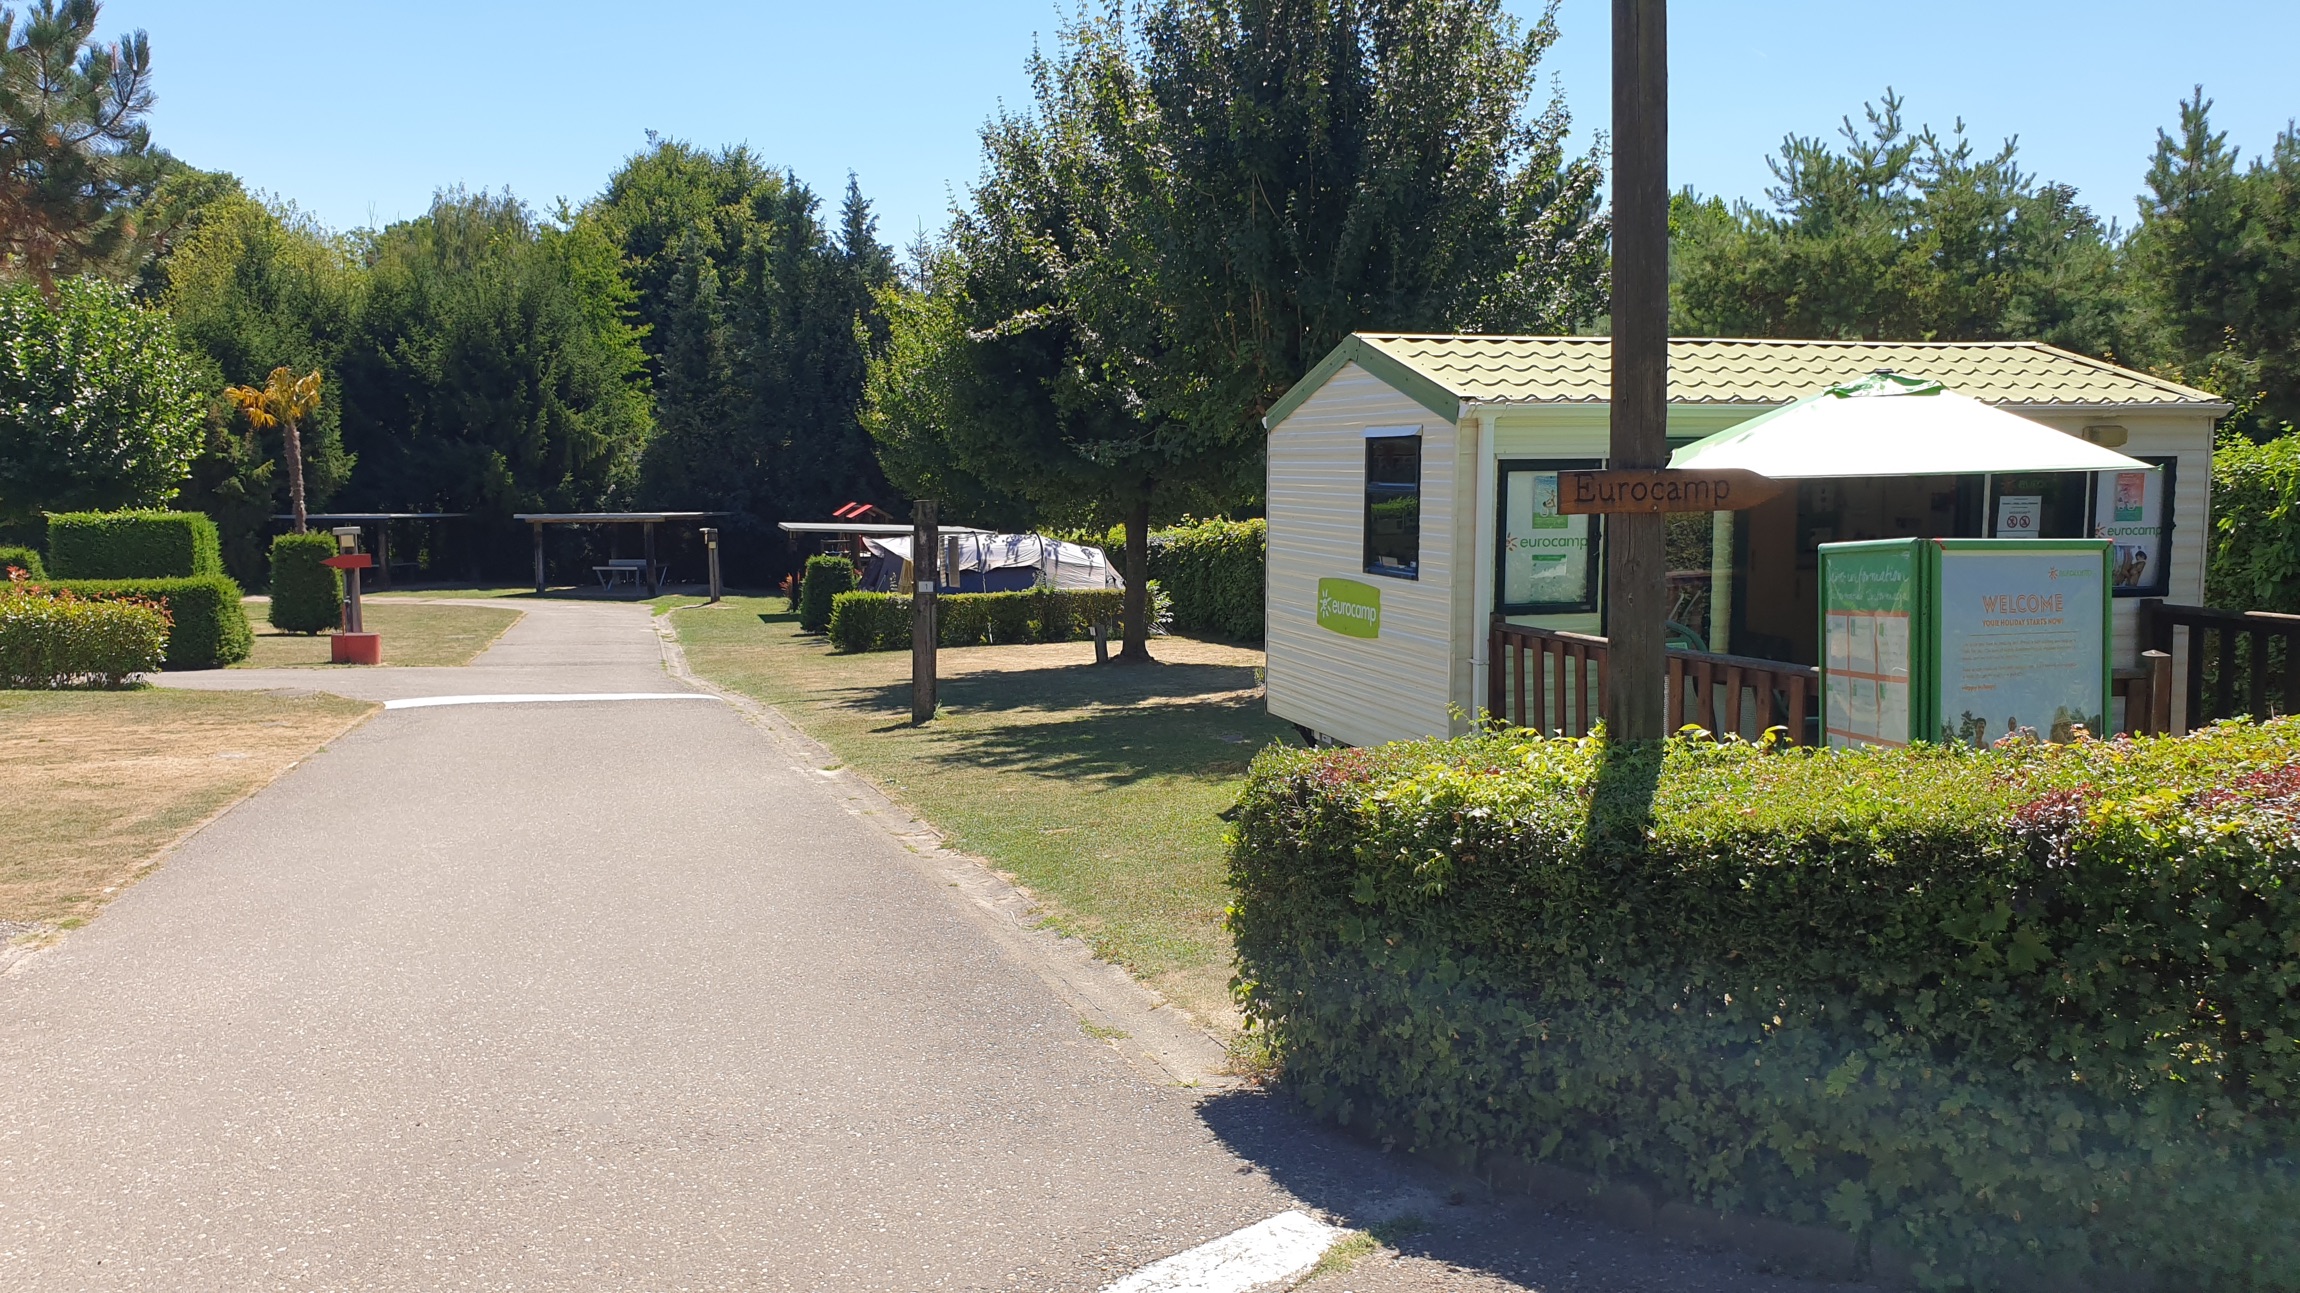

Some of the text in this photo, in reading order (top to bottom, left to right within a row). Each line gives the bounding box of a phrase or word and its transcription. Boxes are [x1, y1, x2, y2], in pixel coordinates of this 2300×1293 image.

[1574, 473, 1730, 506] Eurocamp
[2107, 526, 2162, 538] eurocamp
[1520, 537, 1588, 550] eurocamp
[1982, 594, 2064, 613] WELCOME
[1332, 600, 1377, 627] eurocamp
[2000, 619, 2025, 627] HOLIDAY
[2026, 618, 2047, 626] STARTS
